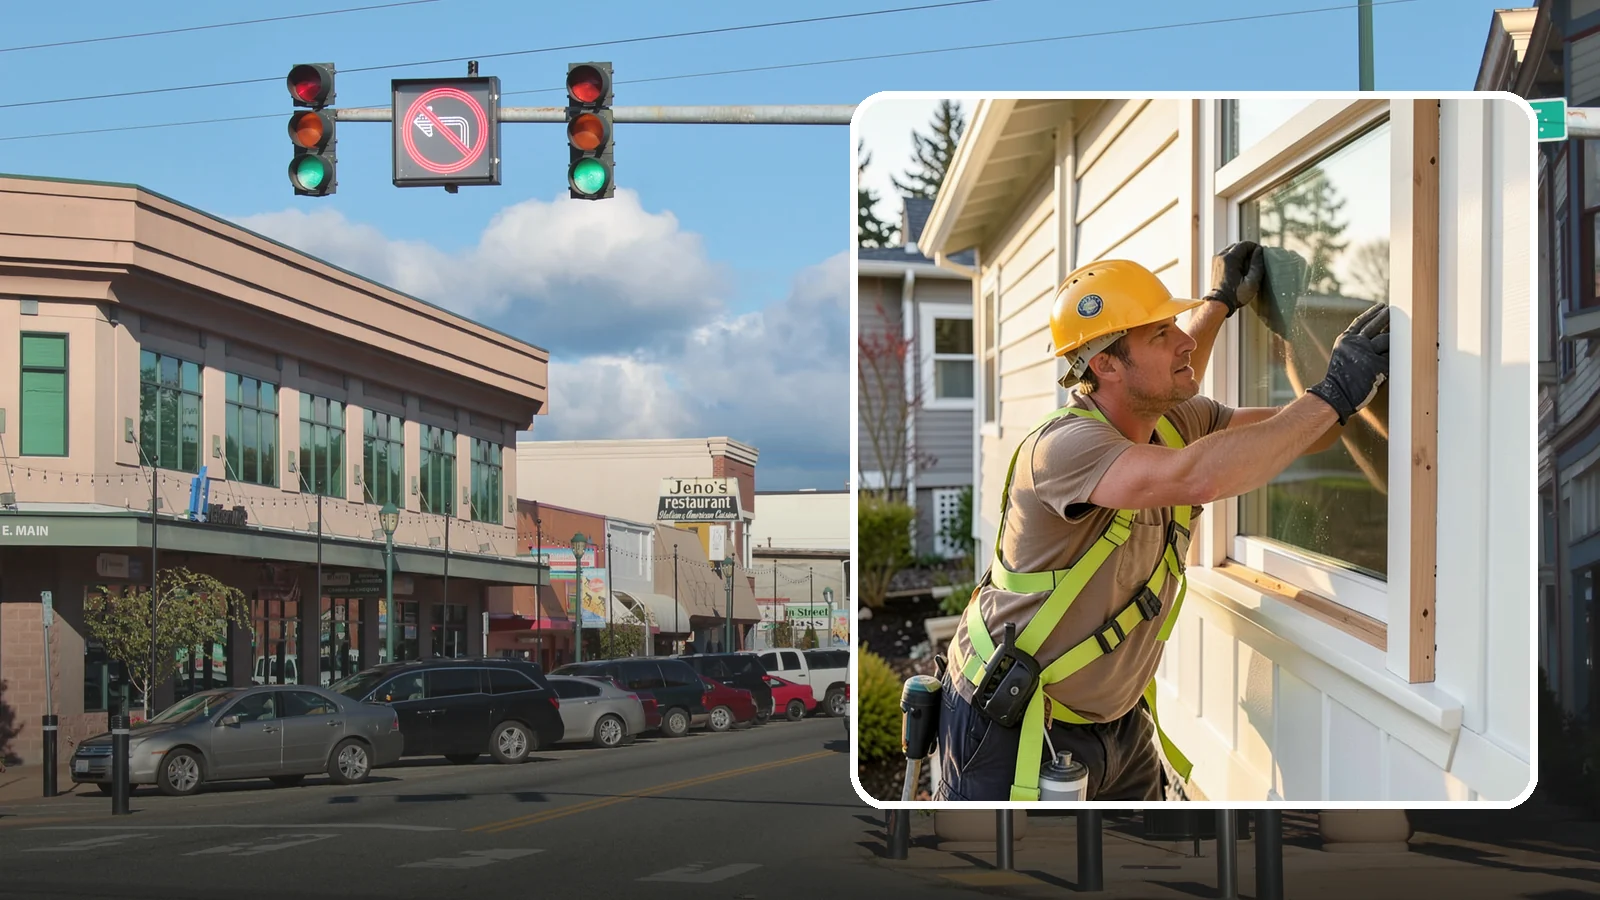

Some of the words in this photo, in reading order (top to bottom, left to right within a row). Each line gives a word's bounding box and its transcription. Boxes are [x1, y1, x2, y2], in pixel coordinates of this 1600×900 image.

[670, 480, 727, 494] Jeno's
[665, 496, 731, 509] restaurant
[659, 510, 681, 519] Italian
[686, 510, 715, 519] American
[715, 509, 738, 519] Cuisine
[2, 525, 13, 536] E.
[15, 525, 49, 536] MAIN
[786, 608, 794, 616] in
[797, 608, 828, 616] Street
